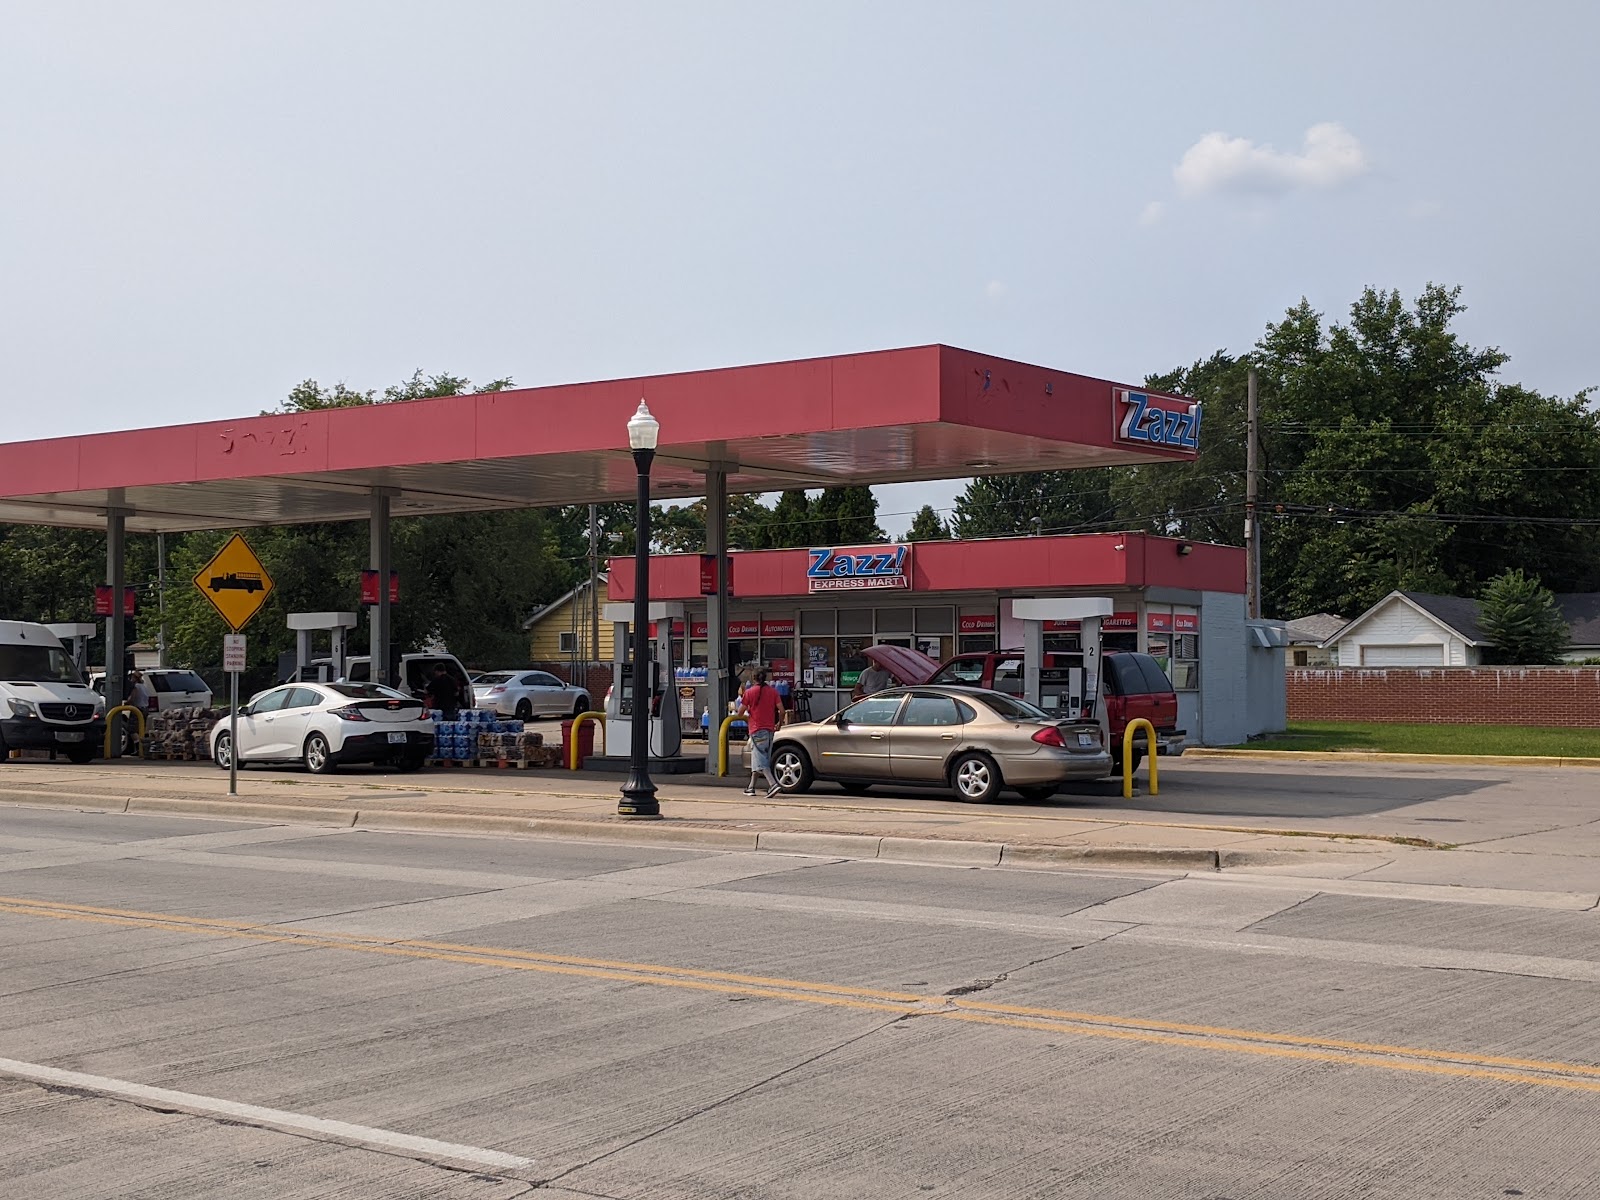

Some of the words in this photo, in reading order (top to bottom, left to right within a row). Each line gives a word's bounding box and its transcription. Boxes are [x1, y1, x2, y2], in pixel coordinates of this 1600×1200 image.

[1120, 391, 1202, 449] Zazz!
[807, 546, 907, 577] Zazz!
[814, 579, 865, 589] EXPRESS
[867, 577, 900, 587] MART
[764, 624, 794, 632] AUTOMOTIVE
[962, 620, 975, 629] COLD
[976, 620, 995, 628] DRINKS
[728, 626, 740, 634] COLD
[741, 625, 758, 633] DRINKS
[334, 645, 339, 653] 6
[661, 642, 666, 650] 4
[1089, 646, 1094, 656] 2
